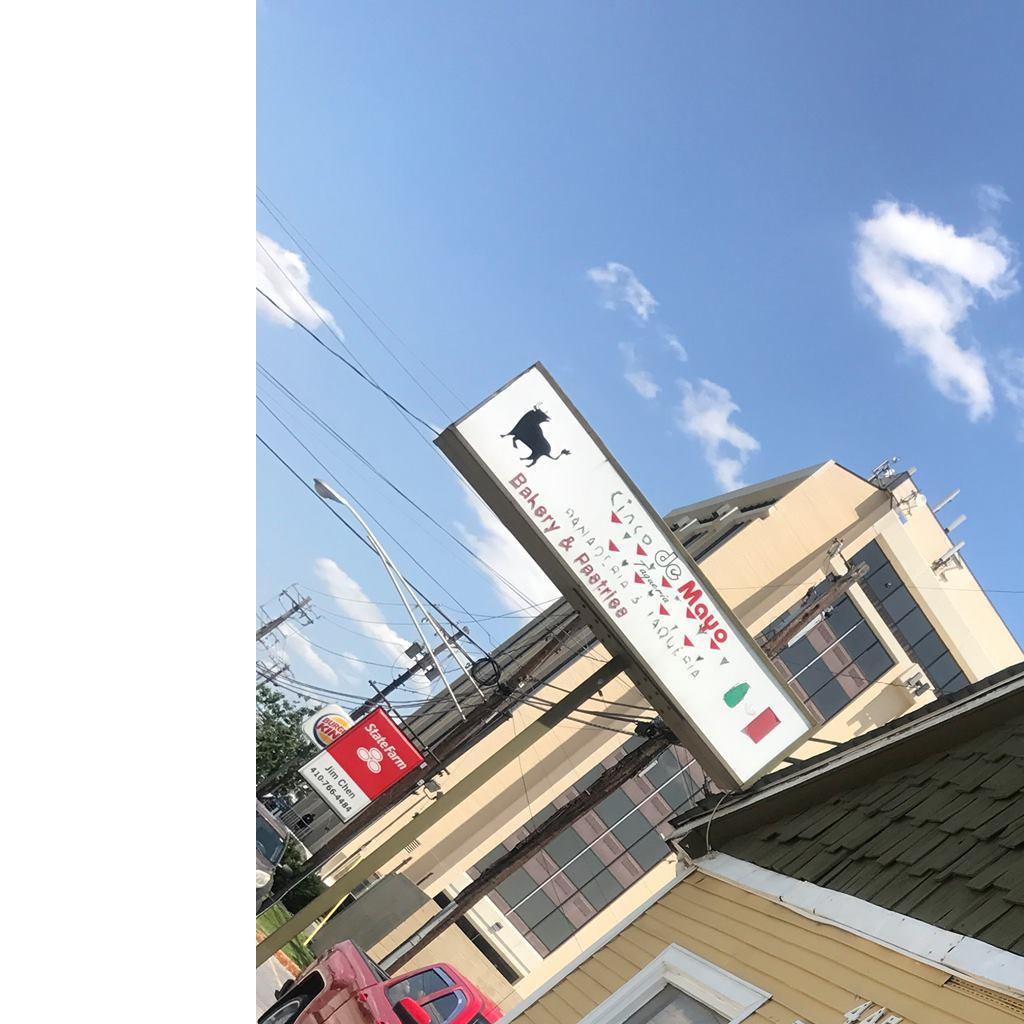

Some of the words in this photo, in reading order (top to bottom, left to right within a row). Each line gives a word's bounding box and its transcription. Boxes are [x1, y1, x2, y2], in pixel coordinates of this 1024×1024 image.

[509, 472, 561, 533] Bakery
[558, 535, 574, 552] &
[573, 553, 628, 619] Pastries
[610, 490, 652, 546] Cinco
[655, 550, 682, 581] de
[677, 580, 728, 643] Mayo
[647, 611, 700, 679] AQUERIA
[310, 767, 352, 812] 410-766-4484
[325, 766, 340, 780] Jim
[337, 778, 355, 799] Chen
